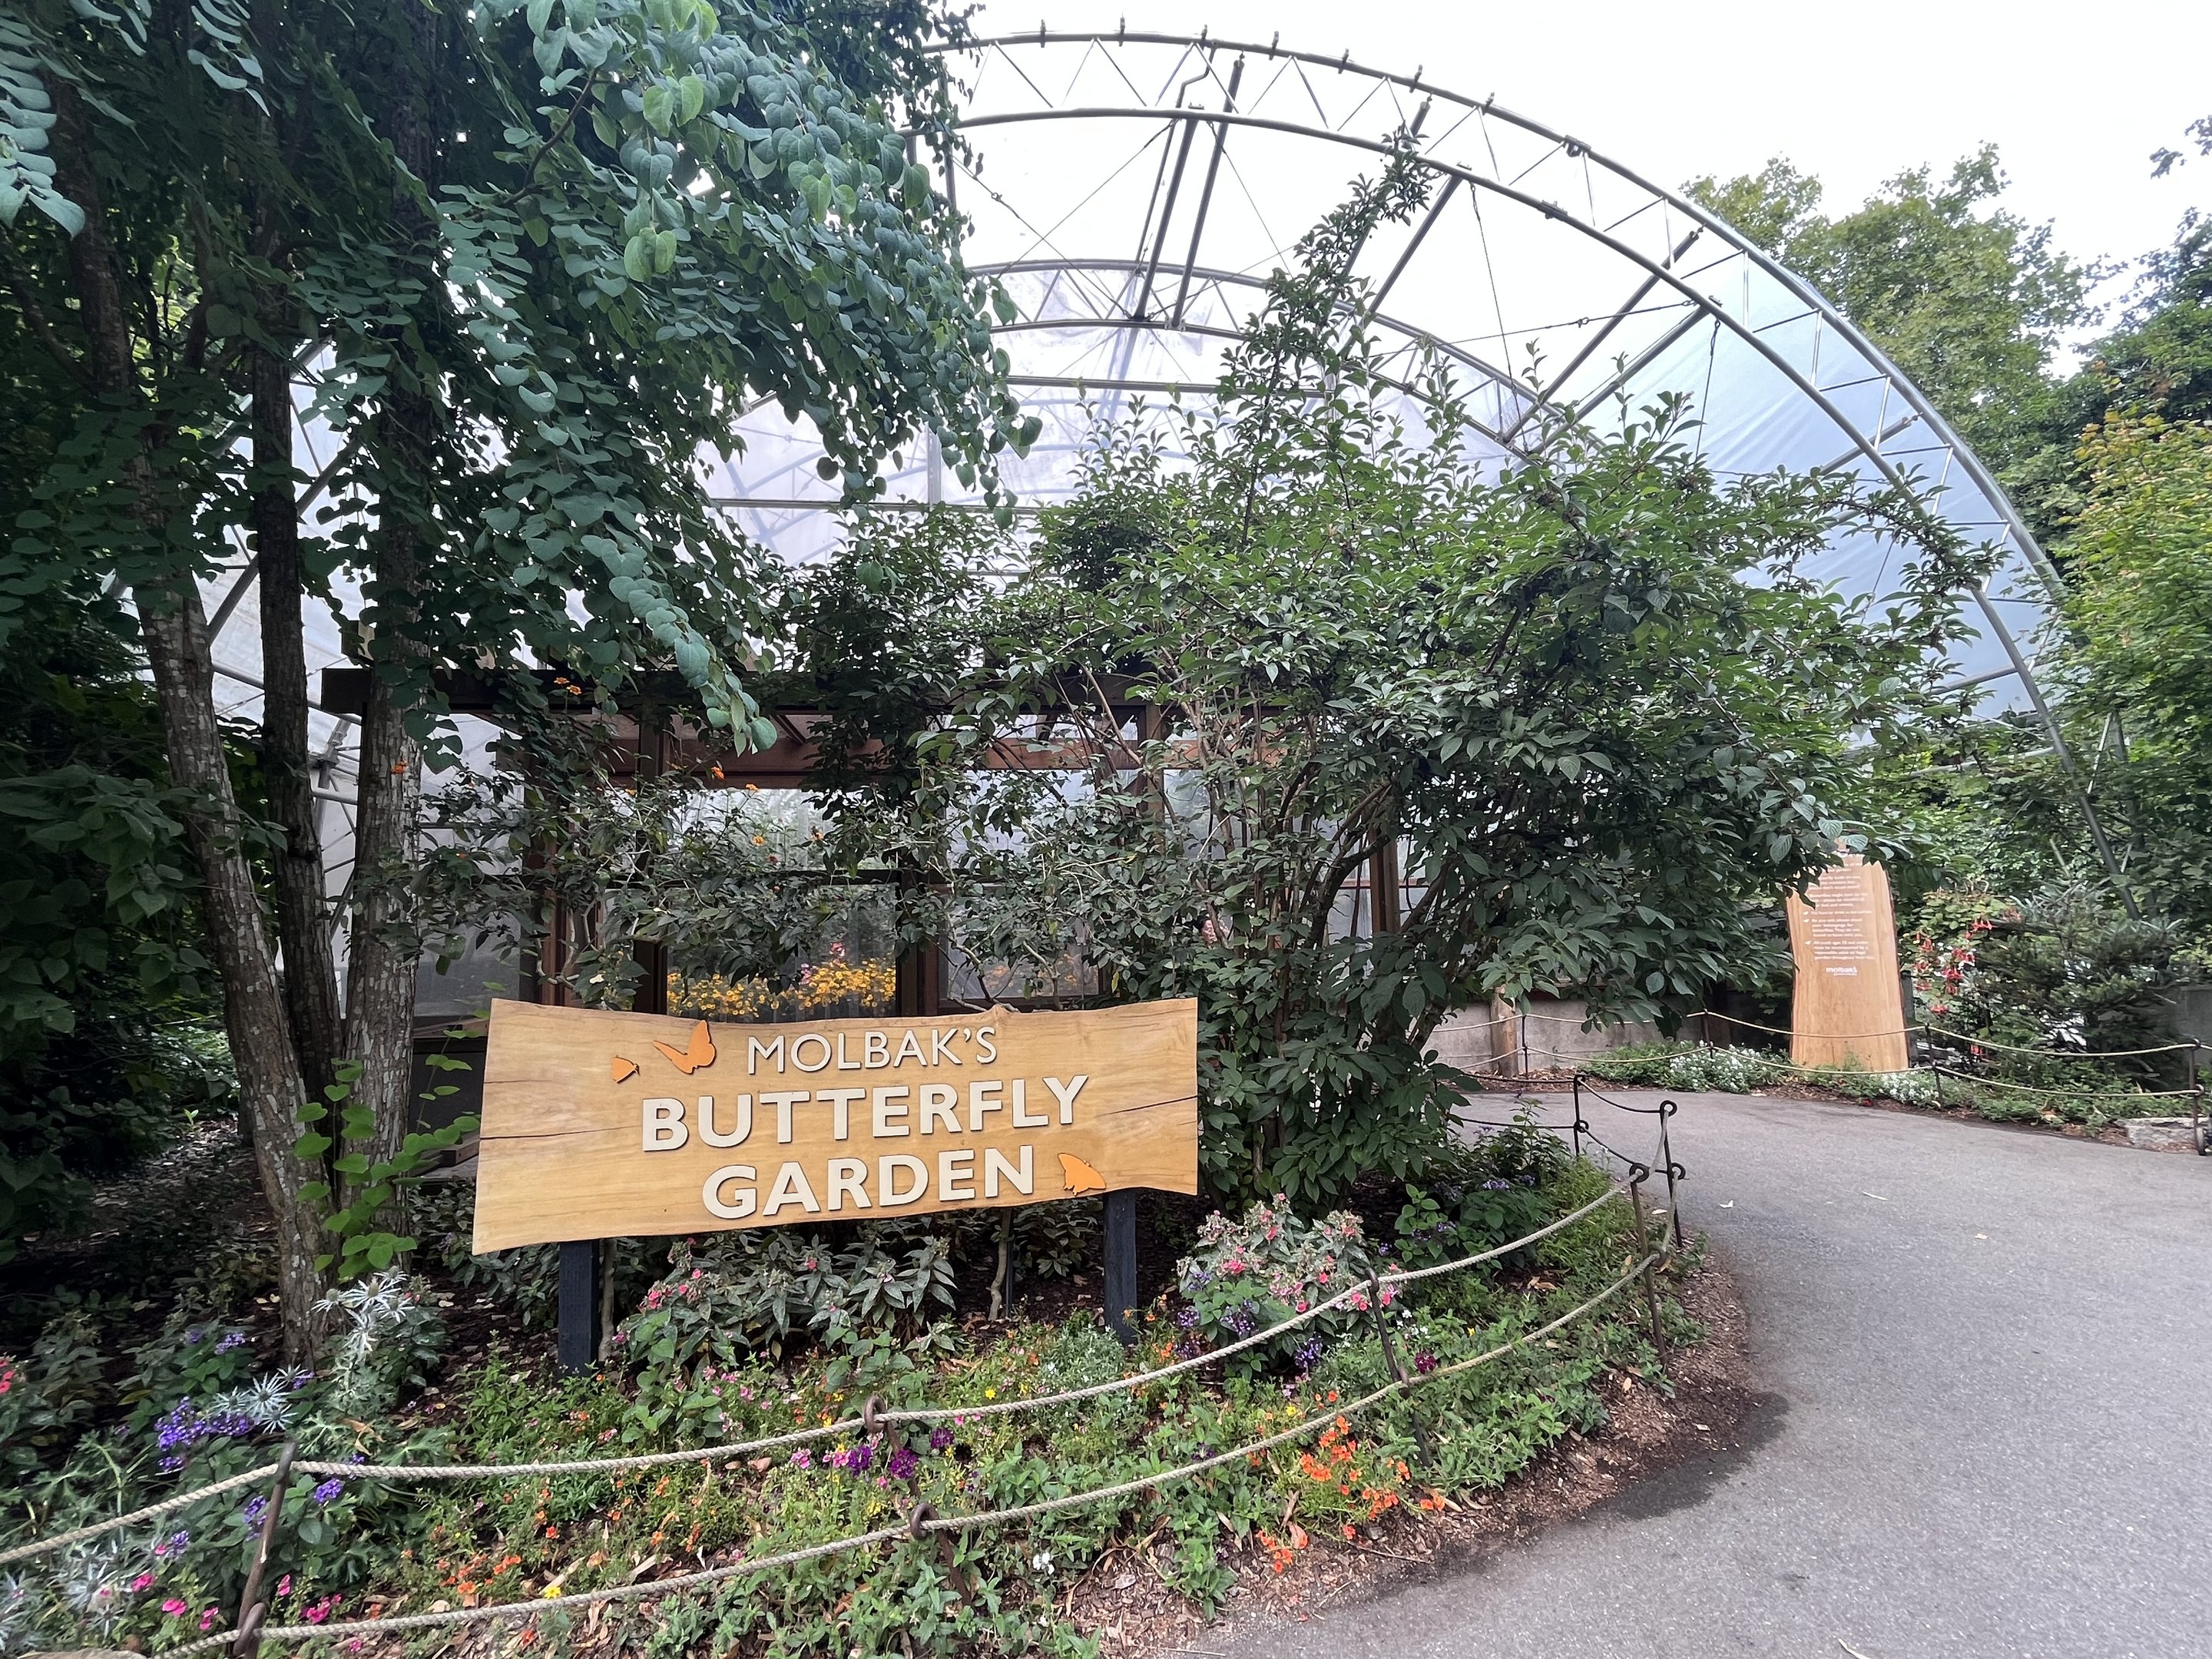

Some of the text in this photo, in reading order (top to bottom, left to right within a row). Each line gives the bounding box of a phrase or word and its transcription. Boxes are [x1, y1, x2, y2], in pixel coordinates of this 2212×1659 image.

[747, 1025, 998, 1075] MOLBAK'S
[641, 1075, 1089, 1153] BUTTERFLY
[700, 1144, 1034, 1220] GARDEN
